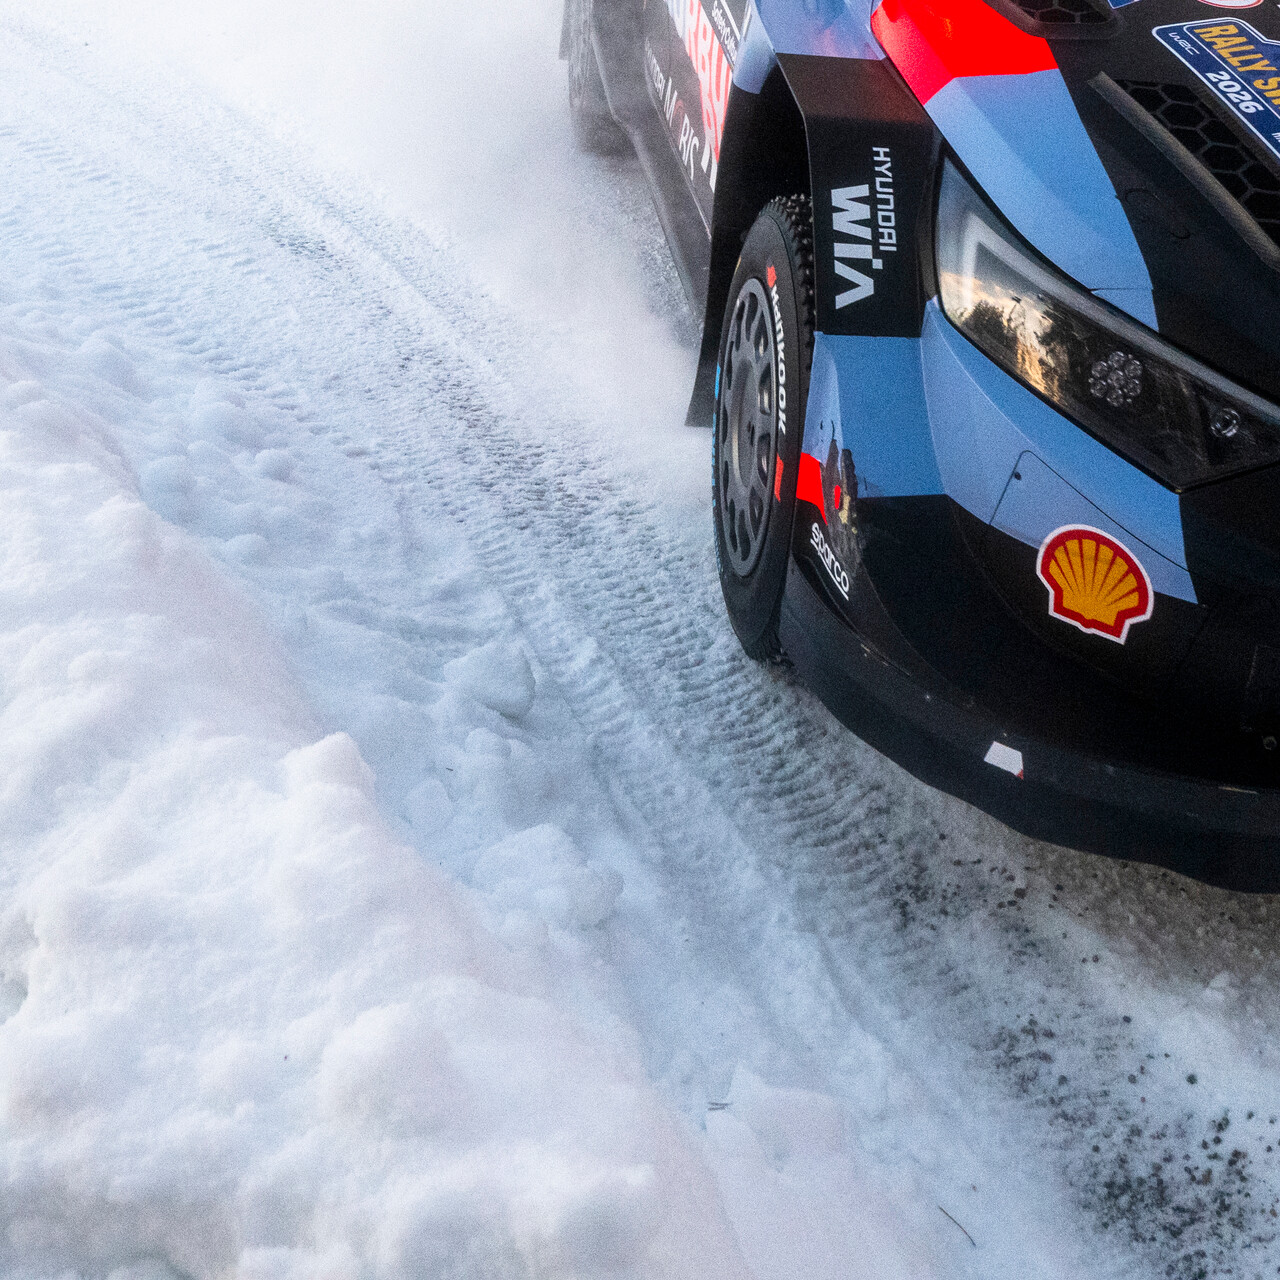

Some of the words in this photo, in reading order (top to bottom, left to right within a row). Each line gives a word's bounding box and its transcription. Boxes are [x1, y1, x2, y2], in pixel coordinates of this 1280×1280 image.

[1194, 25, 1277, 72] RALLY
[1205, 71, 1264, 113] 2026
[872, 147, 897, 251] HYUNDAI
[831, 184, 883, 309] WIA
